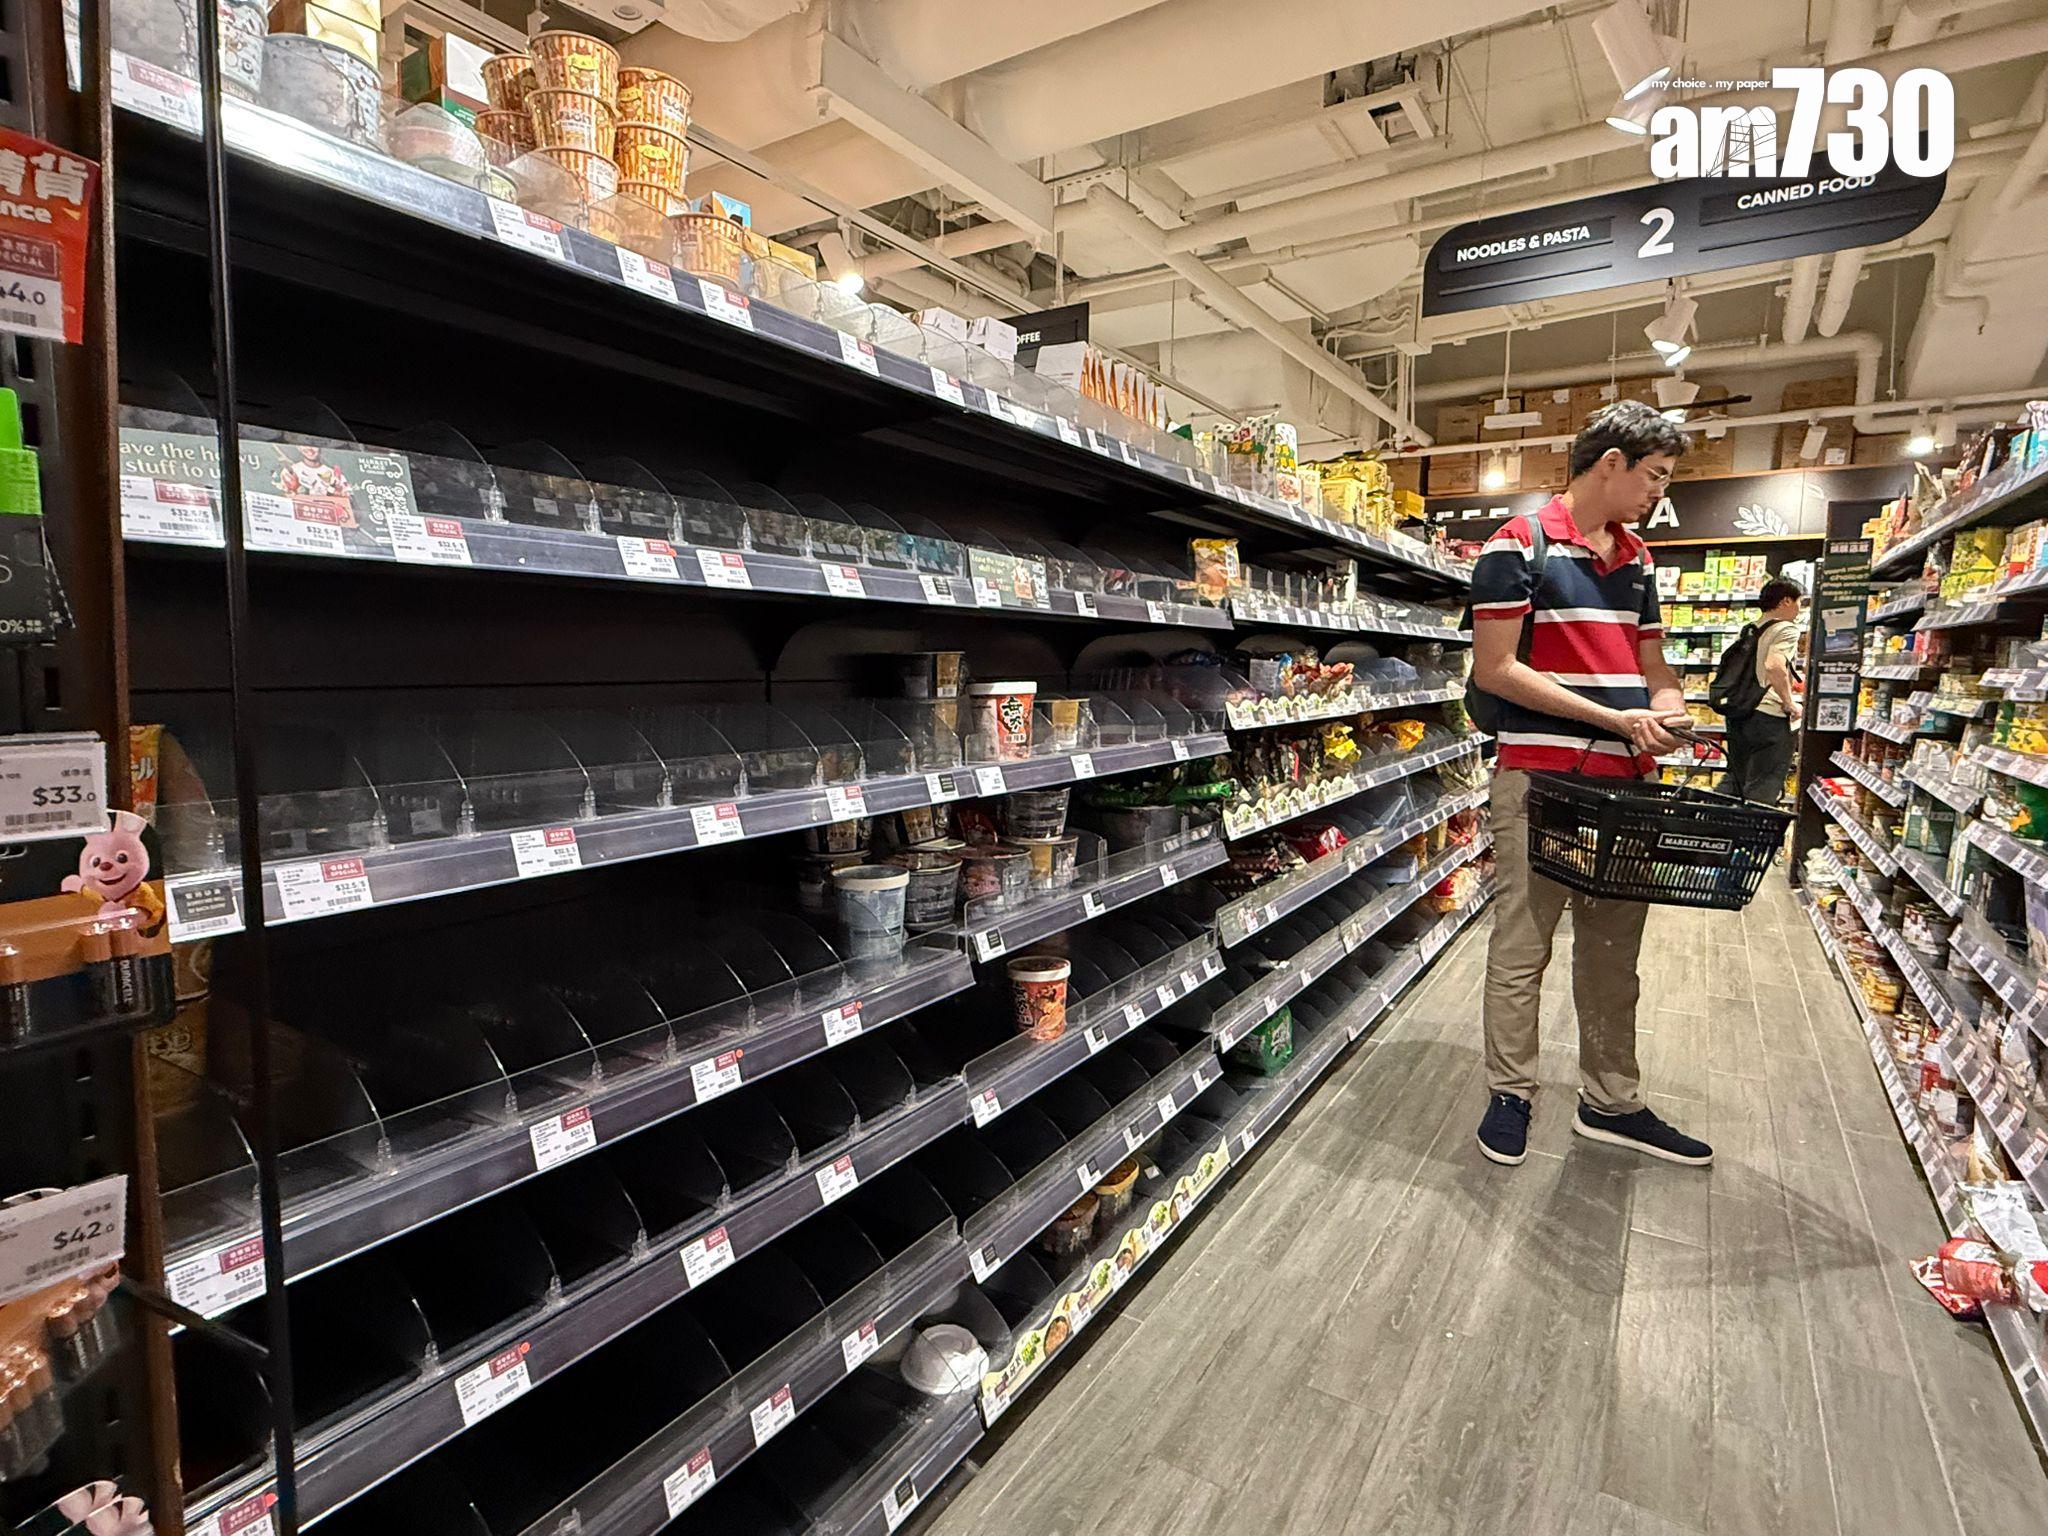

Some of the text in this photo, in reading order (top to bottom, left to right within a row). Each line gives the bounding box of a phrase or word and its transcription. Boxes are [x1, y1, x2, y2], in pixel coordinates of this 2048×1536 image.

[1737, 174, 1876, 209] CANNED FOOD
[1456, 226, 1590, 262] NOODLES & PASTA
[1638, 207, 1674, 258] 2
[161, 443, 195, 460] the
[125, 459, 176, 476] stuff
[182, 463, 203, 478] to
[33, 786, 96, 807] $33.0
[1664, 838, 1727, 850] MARKET PLACE
[53, 1221, 115, 1251] $42.0
